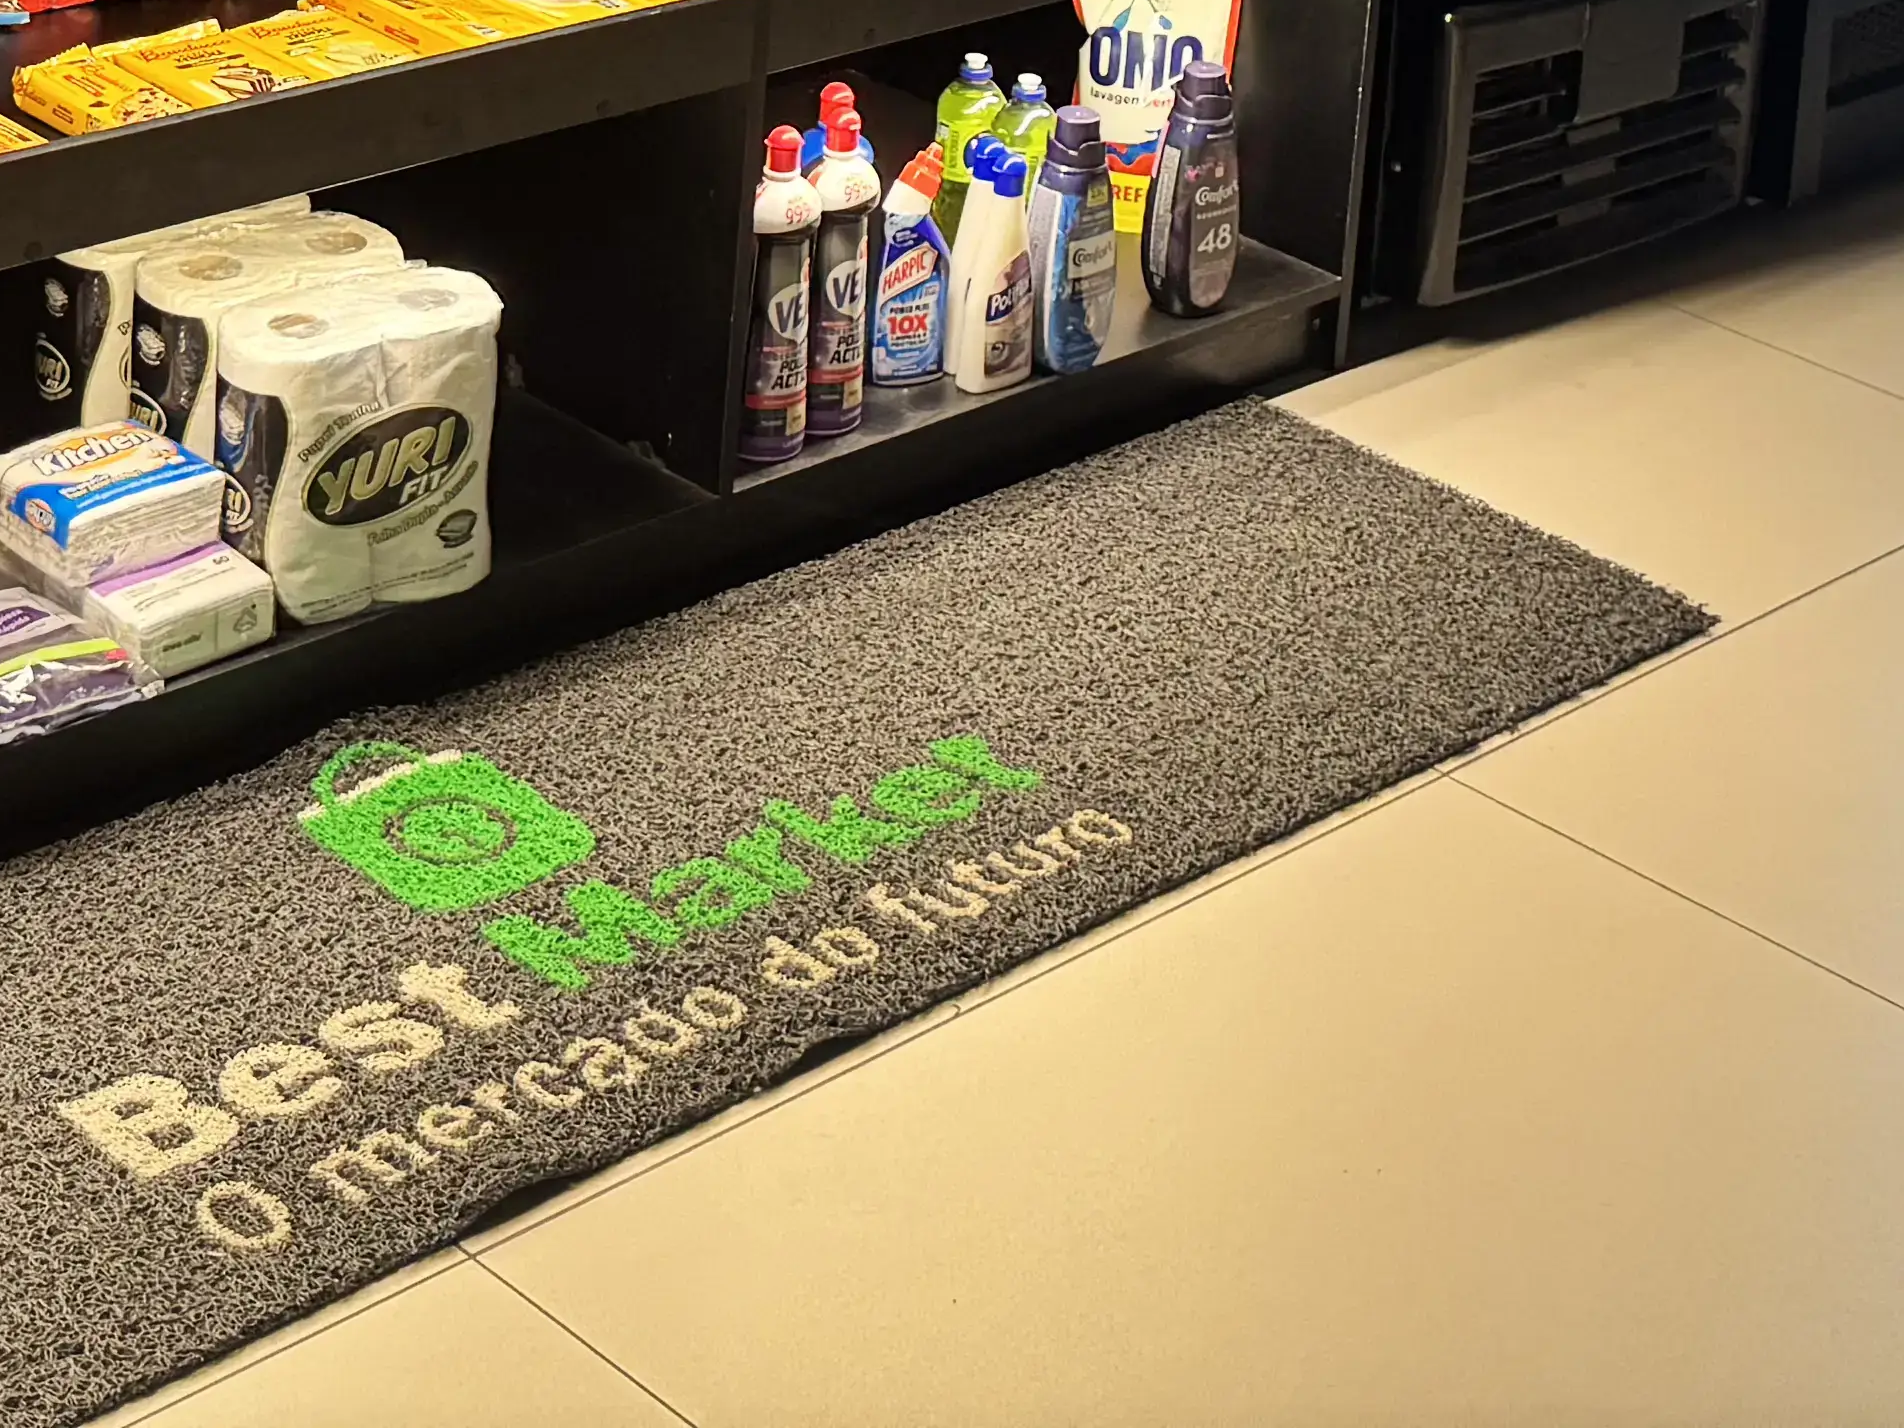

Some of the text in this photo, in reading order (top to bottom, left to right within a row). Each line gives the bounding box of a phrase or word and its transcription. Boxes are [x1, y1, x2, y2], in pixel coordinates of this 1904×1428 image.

[1089, 26, 1204, 91] OMO
[1196, 180, 1239, 206] Comfort
[1072, 239, 1115, 266] Comfort
[1198, 223, 1232, 254] 48
[882, 250, 928, 292] HARPIC
[887, 313, 928, 334] 10X
[34, 430, 152, 476] Kitchen
[316, 416, 458, 516] YURI
[398, 465, 449, 507] FIT
[479, 734, 1045, 990] Market
[196, 805, 1134, 1251] O mercado do futuro
[57, 958, 524, 1183] Best
